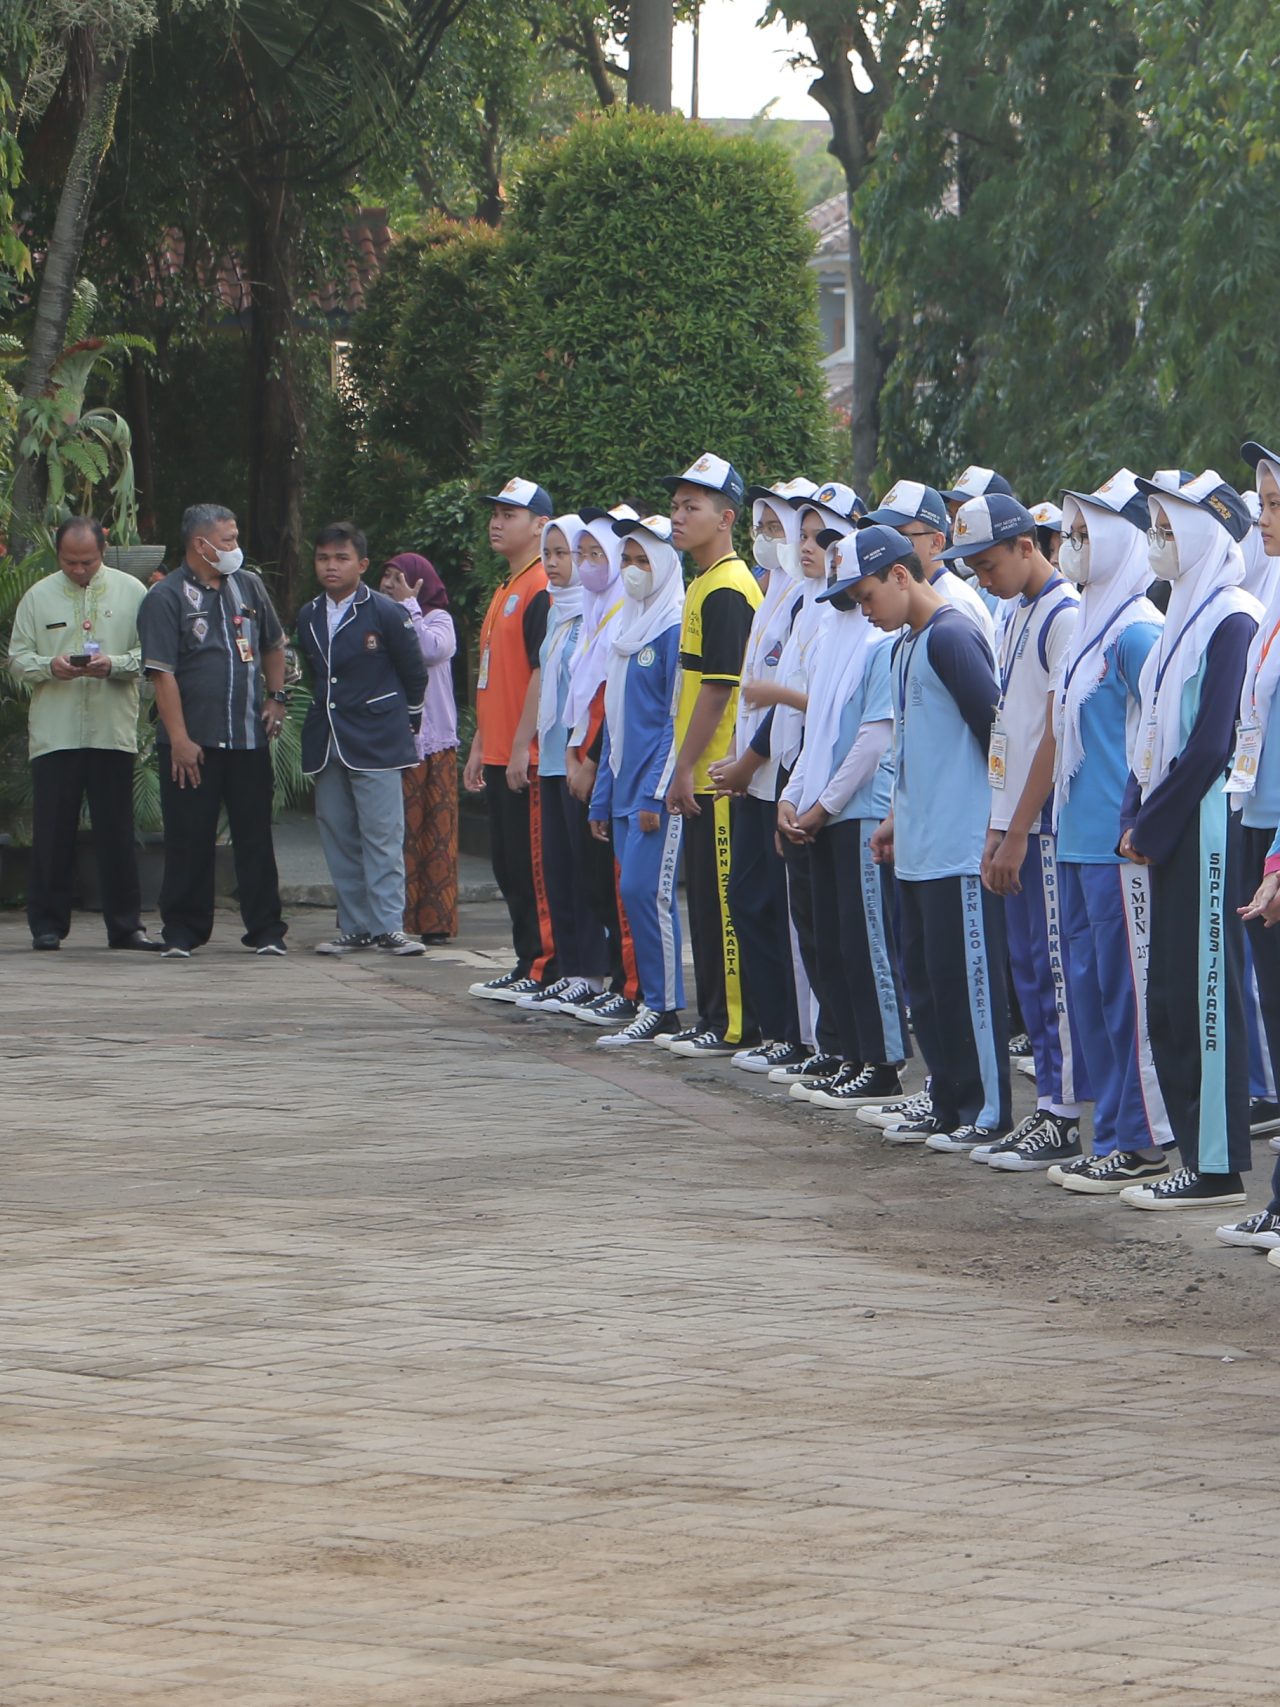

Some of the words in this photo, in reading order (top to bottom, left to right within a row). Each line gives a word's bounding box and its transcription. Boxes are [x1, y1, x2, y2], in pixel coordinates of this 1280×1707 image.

[718, 826, 728, 867] SMPN
[662, 849, 675, 902] JAKARTA
[1044, 874, 1055, 902] 81
[1209, 853, 1221, 908] SMPN
[1131, 877, 1146, 935] SMPN
[1209, 913, 1220, 952] 283
[969, 919, 982, 949] 160
[1049, 907, 1066, 1014] JAKARTA
[973, 956, 987, 1029] JAKARTA
